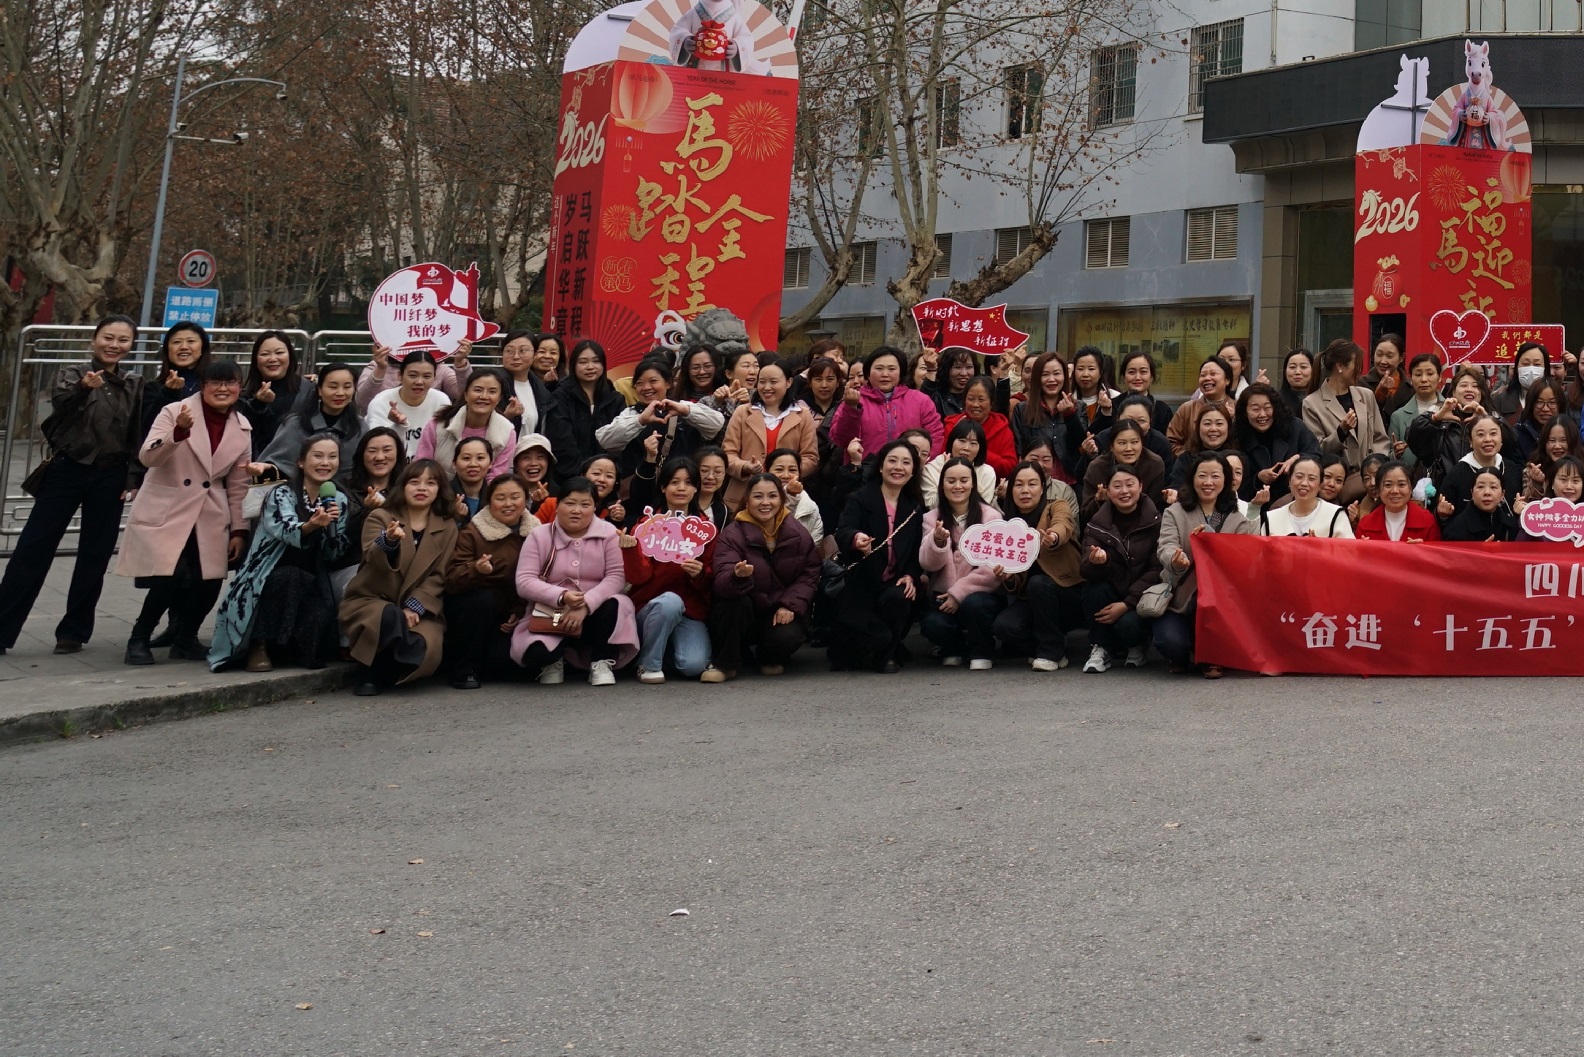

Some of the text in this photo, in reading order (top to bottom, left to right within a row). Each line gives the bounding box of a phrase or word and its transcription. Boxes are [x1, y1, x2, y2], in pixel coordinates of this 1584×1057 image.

[1355, 189, 1421, 244] 2026
[189, 260, 208, 277] 20
[556, 193, 578, 337] 岁启华章
[569, 191, 592, 339] 马跃新程
[380, 293, 424, 306] 中国梦
[394, 309, 437, 322] 川纤梦
[922, 305, 959, 319] 新时代
[407, 324, 451, 337] 我的梦
[948, 319, 984, 333] 新思想
[686, 523, 709, 541] 03.08
[981, 530, 1026, 549] 宠爱自己
[644, 534, 697, 556] 小仙女
[970, 542, 1028, 563] 活出女王范
